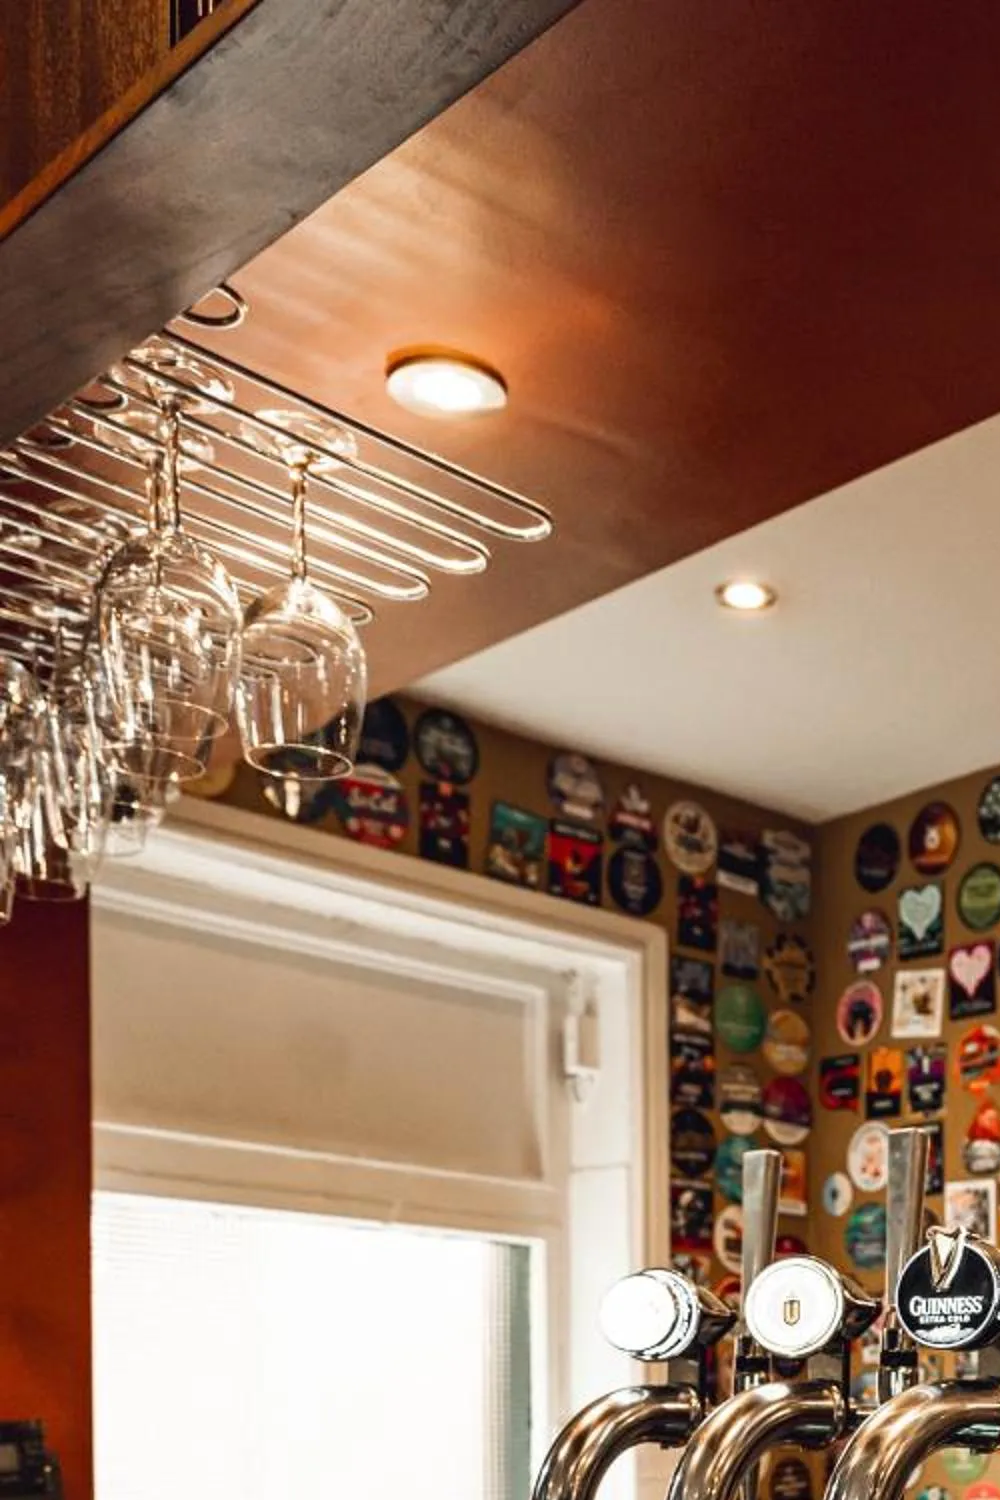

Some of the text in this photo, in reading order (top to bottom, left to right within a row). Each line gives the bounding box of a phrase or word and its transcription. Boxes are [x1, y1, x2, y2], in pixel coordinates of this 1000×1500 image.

[909, 1295, 984, 1317] GUINNESS
[919, 1312, 971, 1325] EXTRA COLD
